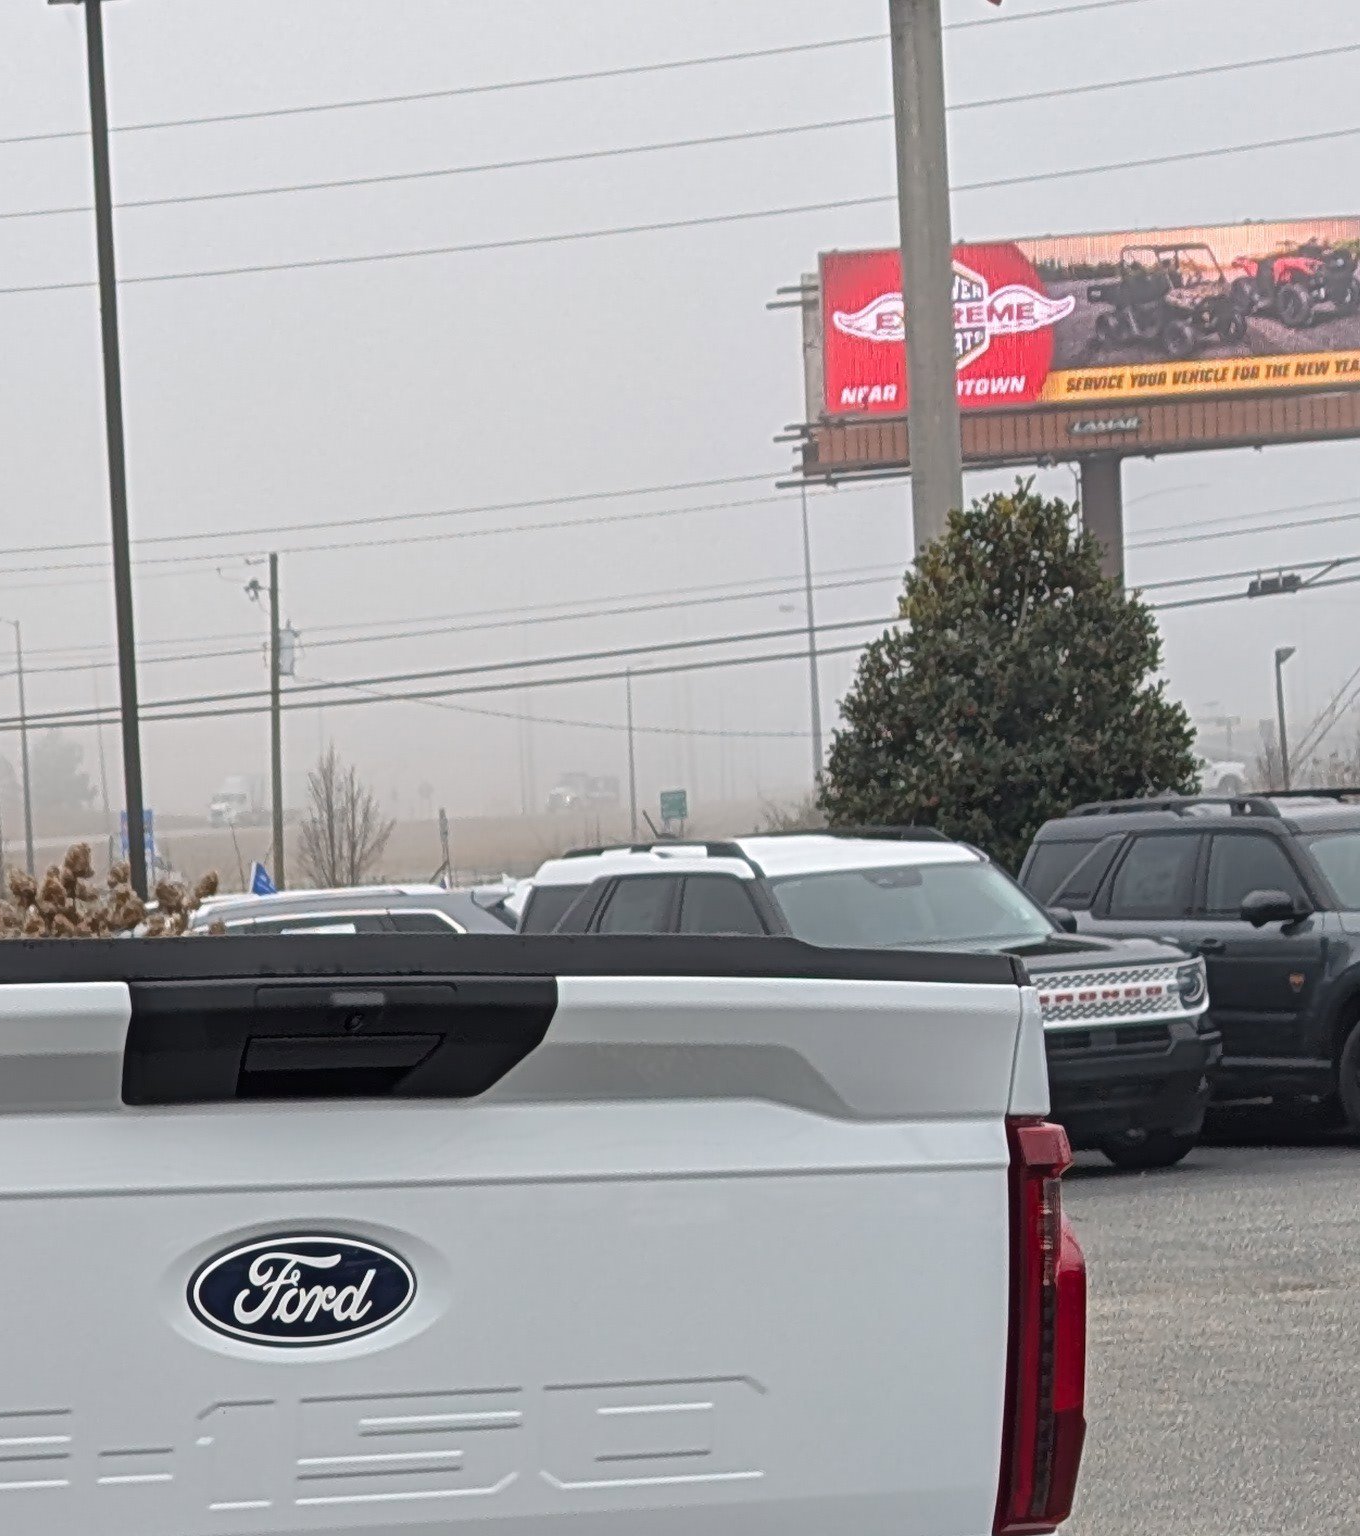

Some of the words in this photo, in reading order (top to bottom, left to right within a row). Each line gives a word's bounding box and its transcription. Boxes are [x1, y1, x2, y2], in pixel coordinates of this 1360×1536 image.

[1067, 374, 1124, 392] SERVICE
[1130, 371, 1167, 388] YOUR
[1173, 366, 1229, 385] VEHICLE
[1232, 365, 1260, 381] FOR
[1265, 363, 1290, 379] THE
[1294, 360, 1330, 376] NEW
[841, 384, 897, 404] NEAR
[233, 1252, 377, 1325] Ford
